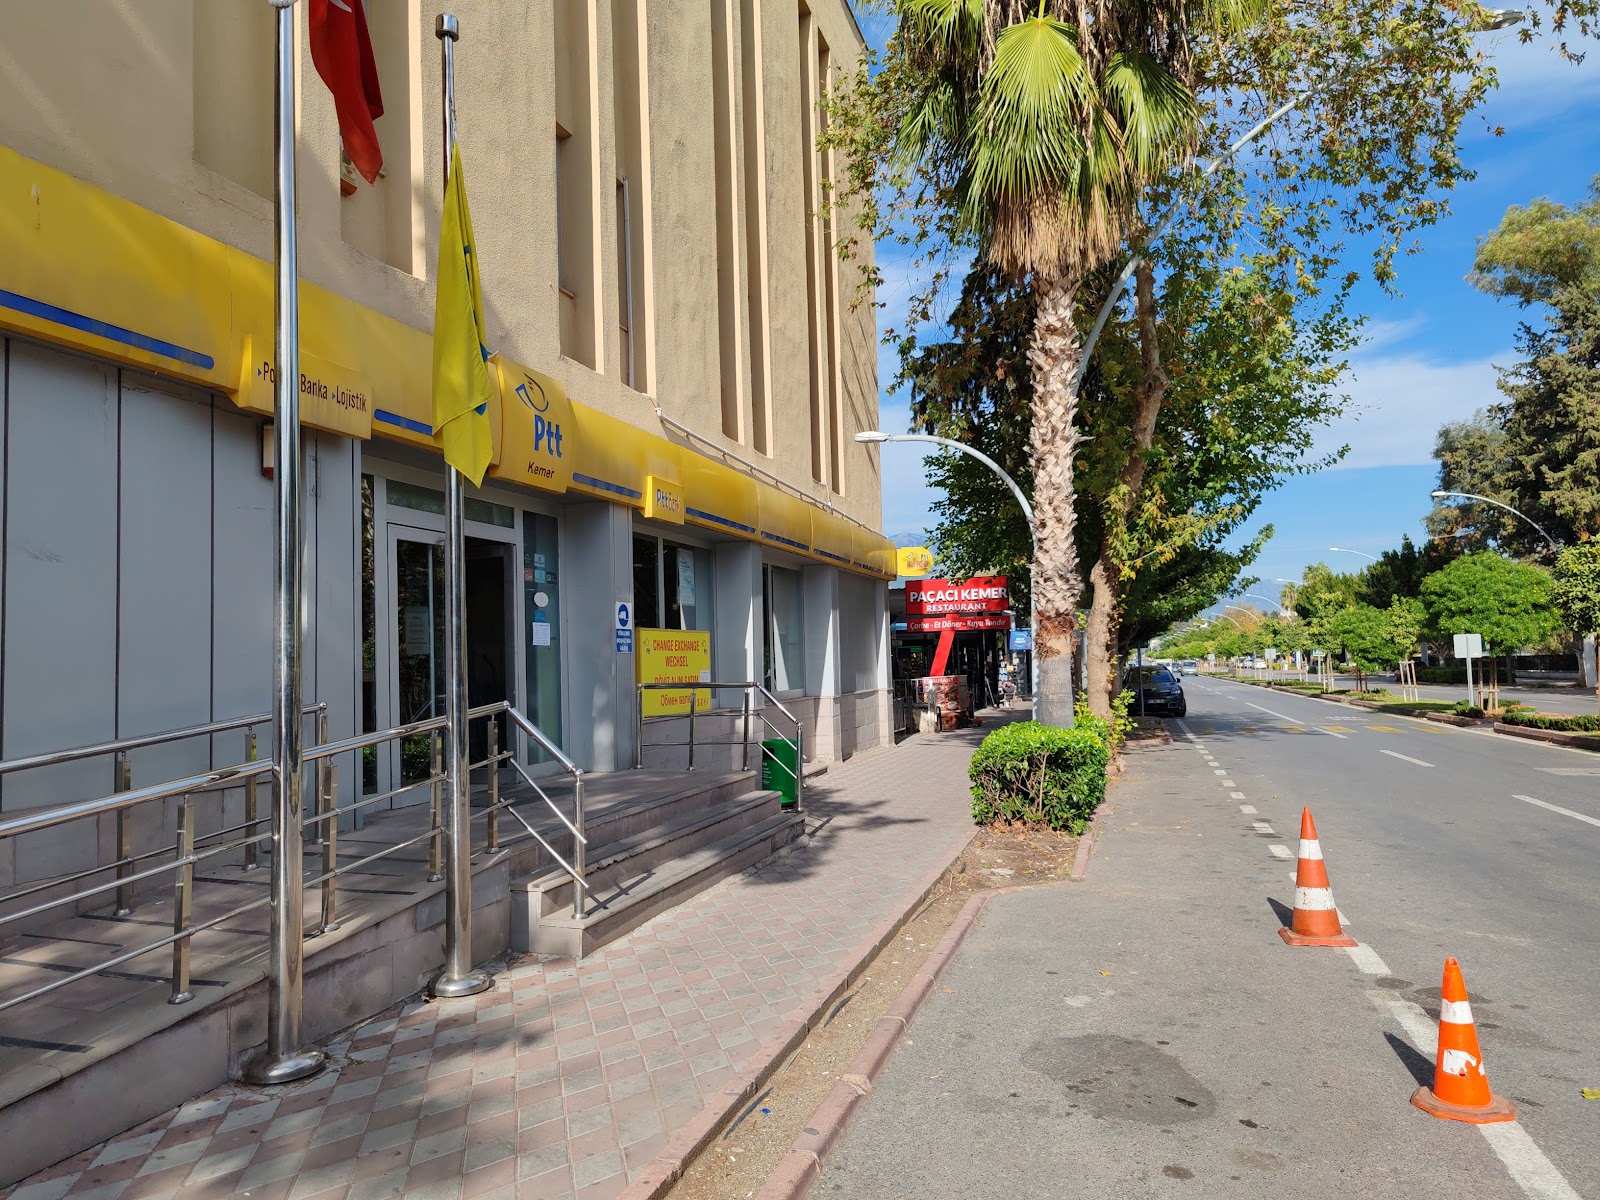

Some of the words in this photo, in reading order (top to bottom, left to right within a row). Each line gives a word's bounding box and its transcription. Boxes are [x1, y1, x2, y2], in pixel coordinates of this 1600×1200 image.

[300, 373, 328, 400] Banka
[336, 385, 367, 413] Lojistik
[534, 414, 563, 459] Ptt
[527, 461, 555, 479] Kemer
[909, 589, 958, 604] PAÇACI
[961, 587, 1008, 601] KEMER
[926, 602, 987, 613] RESTAURANT
[910, 621, 929, 630] Çorba
[933, 621, 941, 629] Et
[942, 620, 962, 628] Döner
[652, 639, 674, 651] CHANGE
[674, 640, 700, 652] EXCHANGE
[665, 655, 689, 667] WECHSEL
[679, 695, 692, 705] валю
